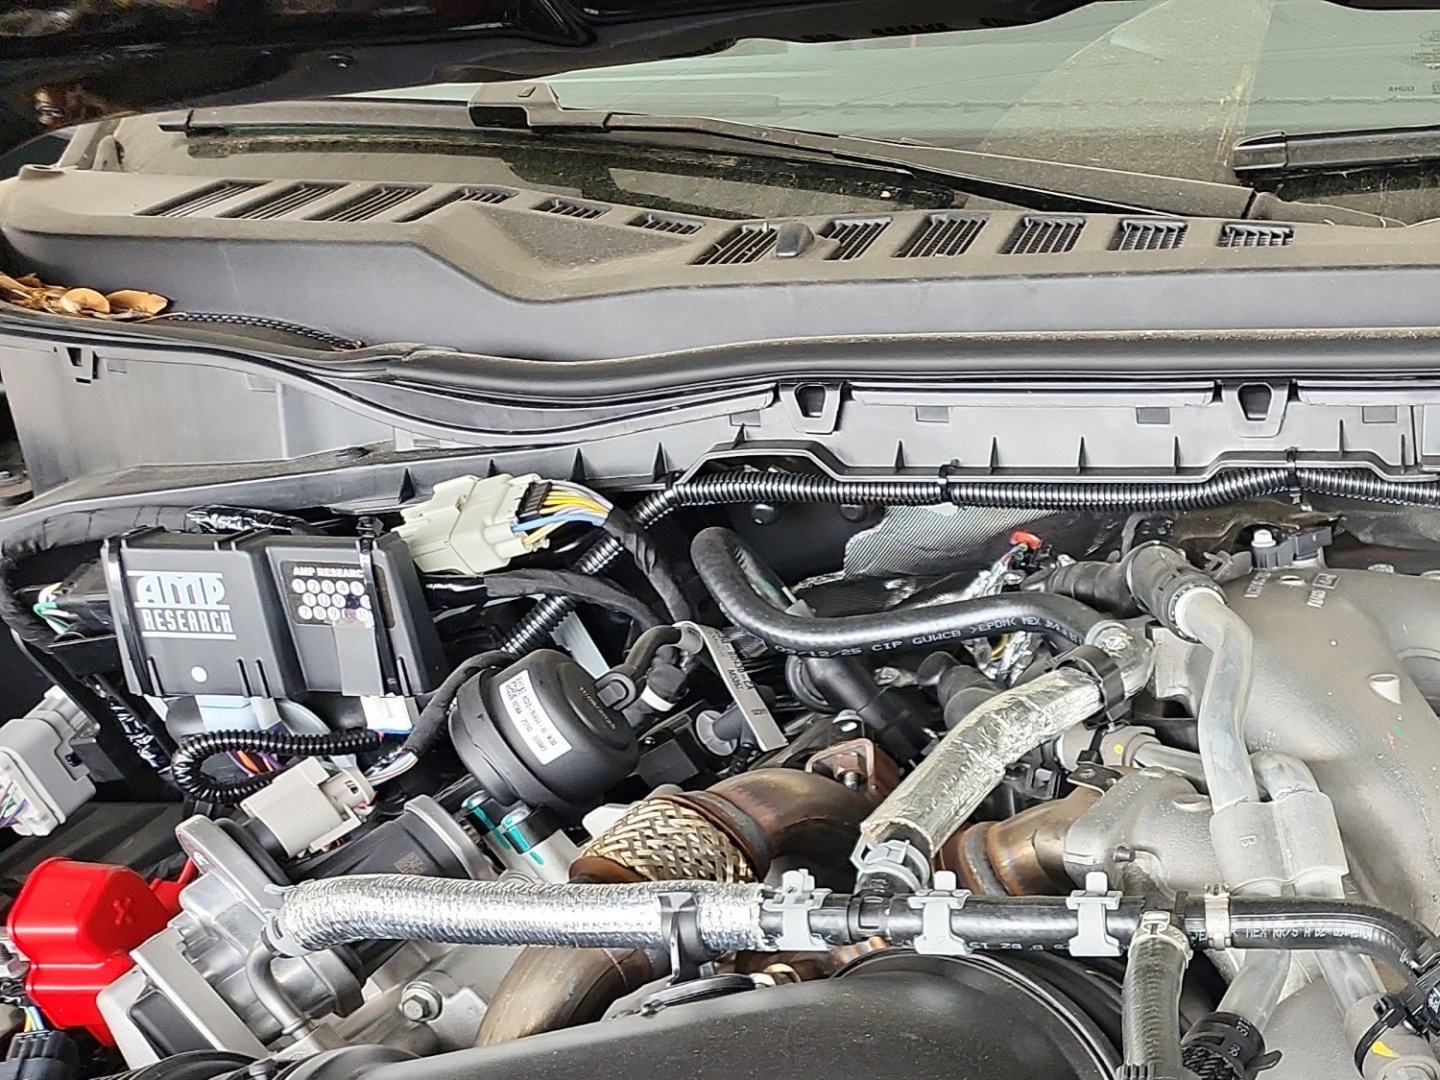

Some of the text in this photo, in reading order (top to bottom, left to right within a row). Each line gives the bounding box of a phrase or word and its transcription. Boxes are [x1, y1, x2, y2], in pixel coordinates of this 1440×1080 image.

[293, 567, 364, 578] AMP RESEARC
[136, 572, 226, 607] AMP
[142, 608, 234, 634] RESEARCH
[871, 639, 902, 652] CIP
